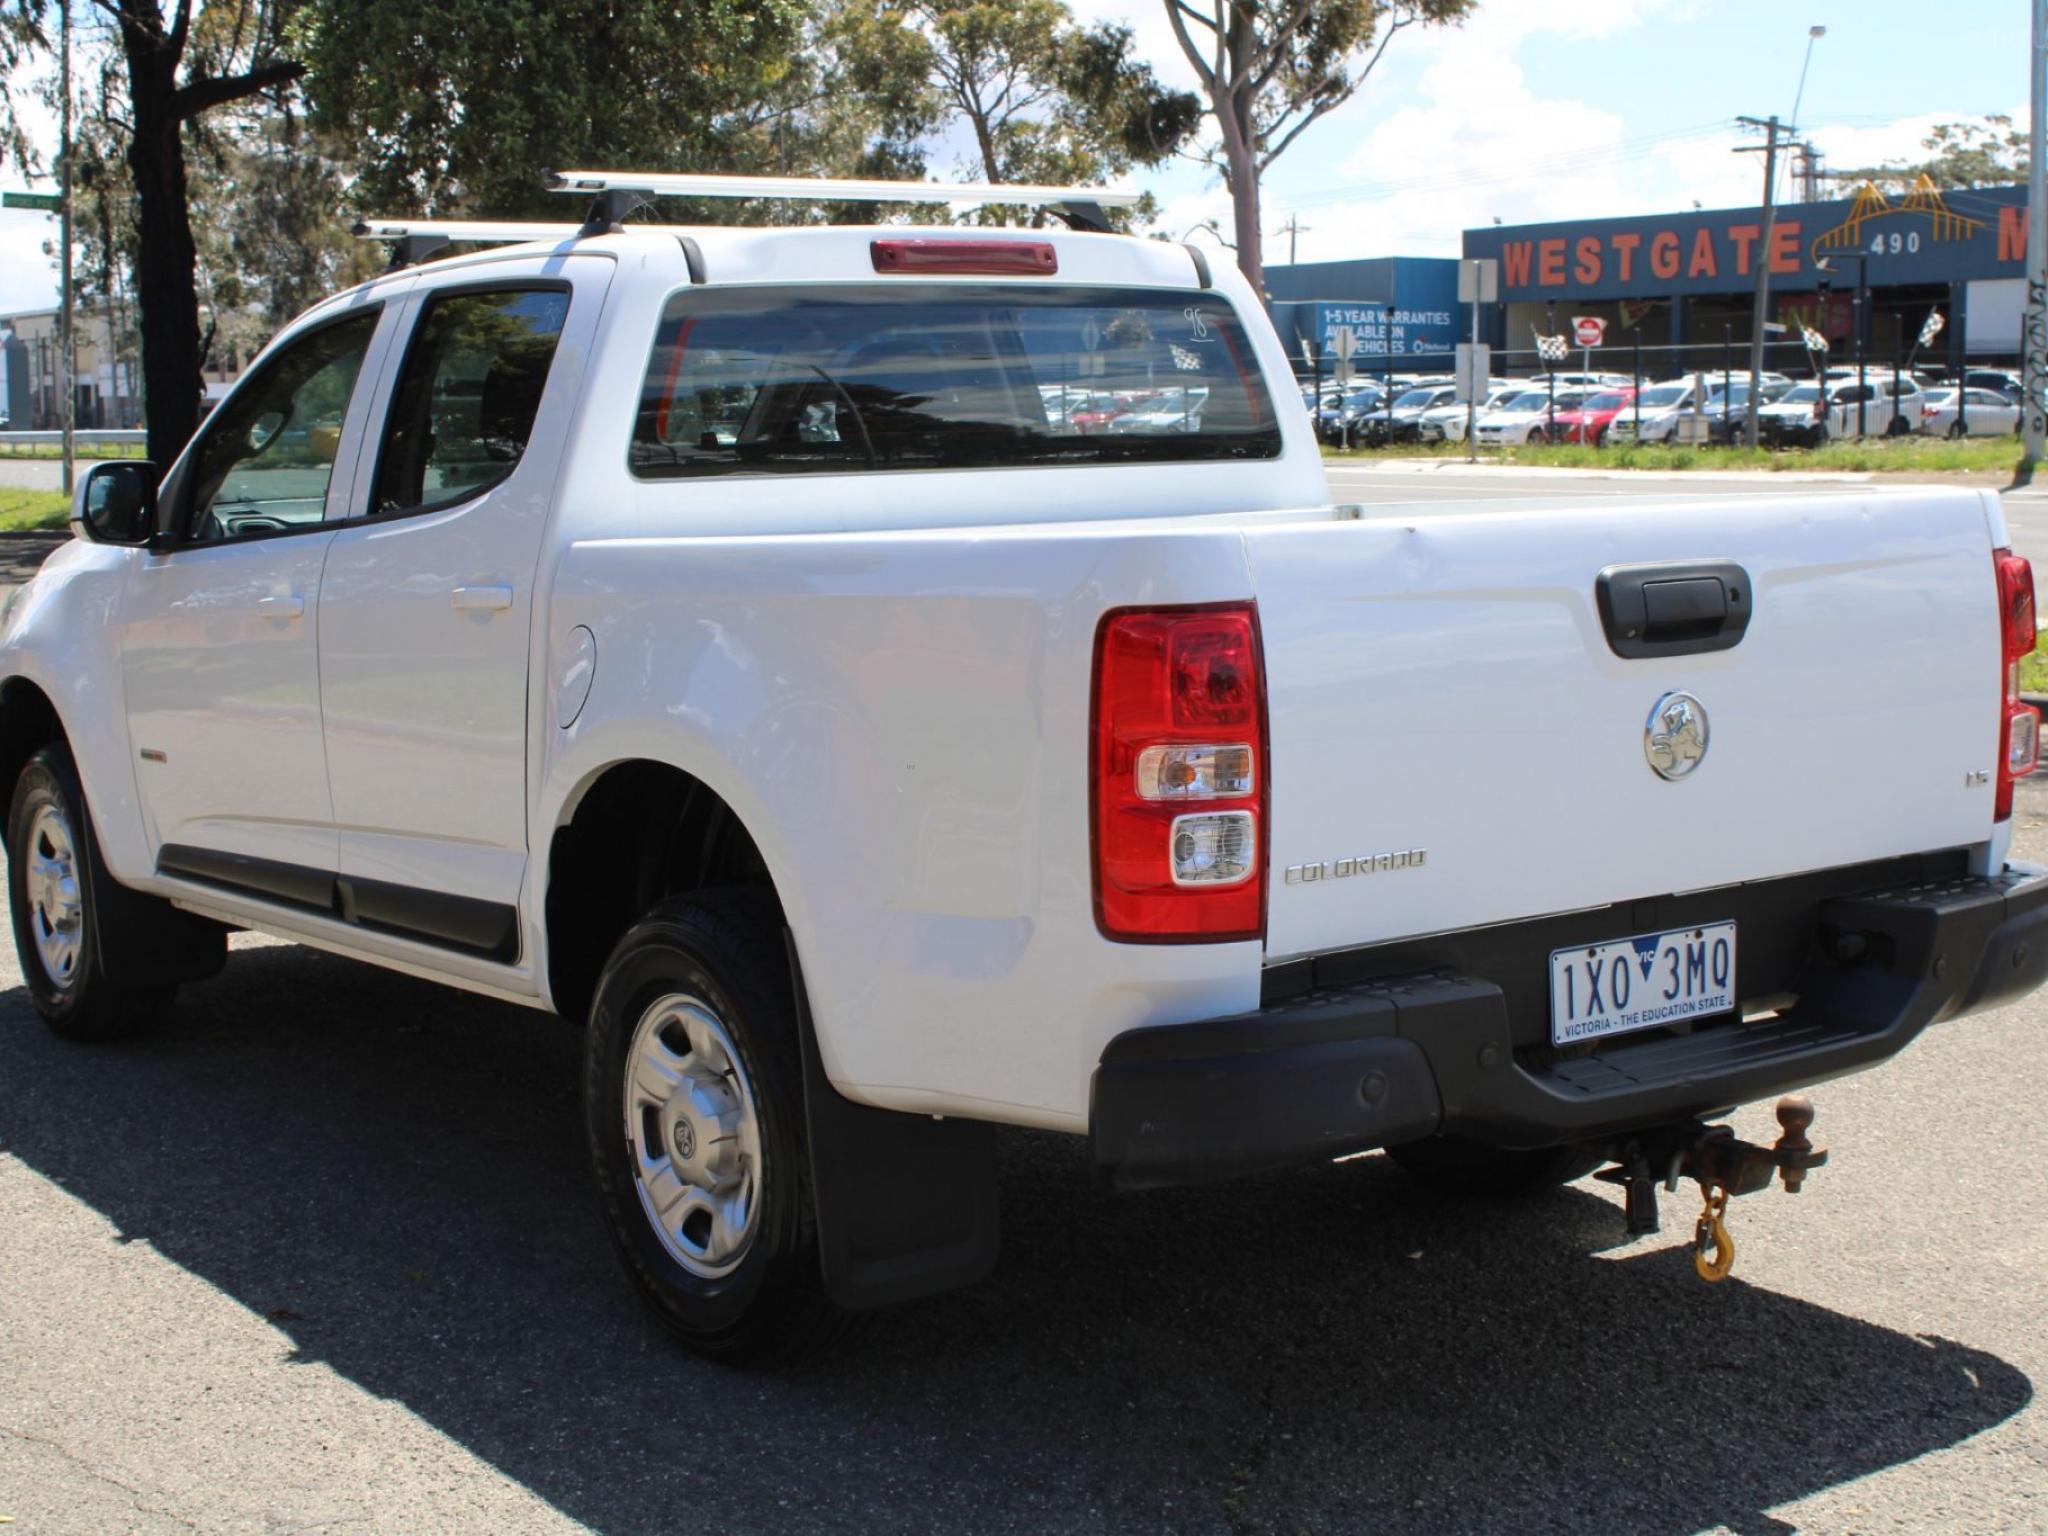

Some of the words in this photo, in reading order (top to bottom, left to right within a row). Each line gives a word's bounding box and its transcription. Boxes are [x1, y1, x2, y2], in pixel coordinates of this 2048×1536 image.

[1503, 222, 1801, 288] WESTGATE
[1870, 232, 1920, 255] 490
[1325, 310, 1342, 324] 1-5
[1344, 310, 1375, 324] YEAR
[1325, 325, 1387, 339] AVLABLE
[1357, 340, 1405, 353] EHICLES
[1285, 848, 1427, 884] COLORADO
[1636, 949, 1655, 962] VIC
[1663, 938, 1729, 1000] 3MQ
[1565, 1018, 1611, 1037] VICTORIA
[1620, 1012, 1640, 1025] THE
[1642, 1001, 1696, 1022] EDUCATION
[1698, 995, 1726, 1010] STATE
